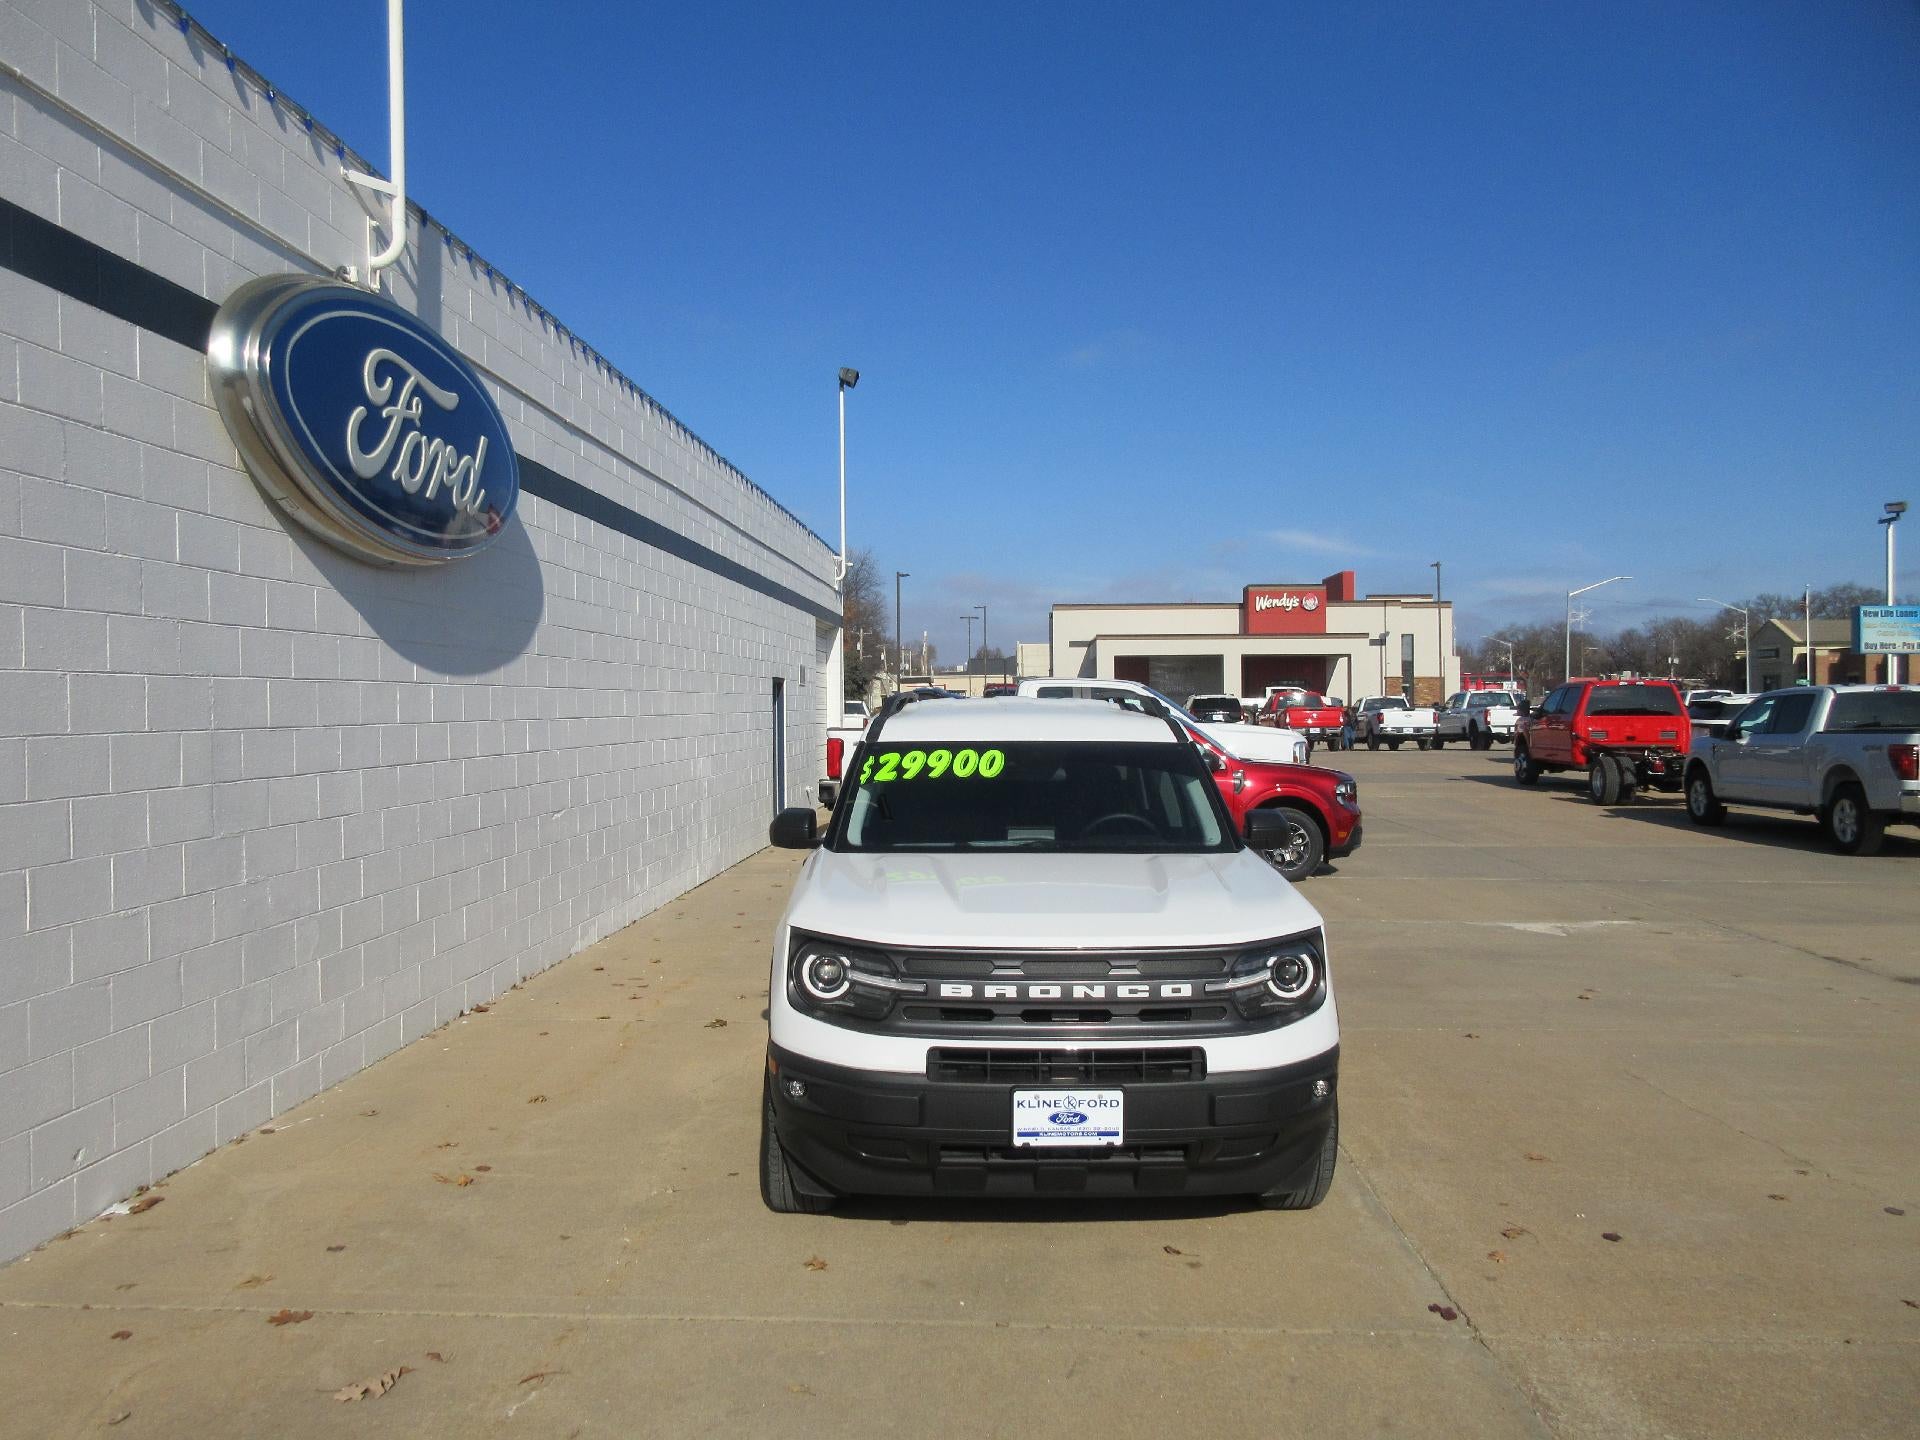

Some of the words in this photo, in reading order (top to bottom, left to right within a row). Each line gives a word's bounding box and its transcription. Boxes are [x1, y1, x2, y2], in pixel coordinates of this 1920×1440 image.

[346, 348, 488, 516] Ford
[1255, 593, 1299, 611] Wendy's
[1862, 610, 1879, 618] New
[1880, 610, 1894, 618] Life
[1864, 642, 1878, 650] Buy
[859, 748, 1005, 785] $29900
[940, 983, 1192, 998] BRONCO
[1017, 1100, 1061, 1108] KLINE
[1078, 1099, 1119, 1108] FORD
[1056, 1112, 1081, 1123] Ford
